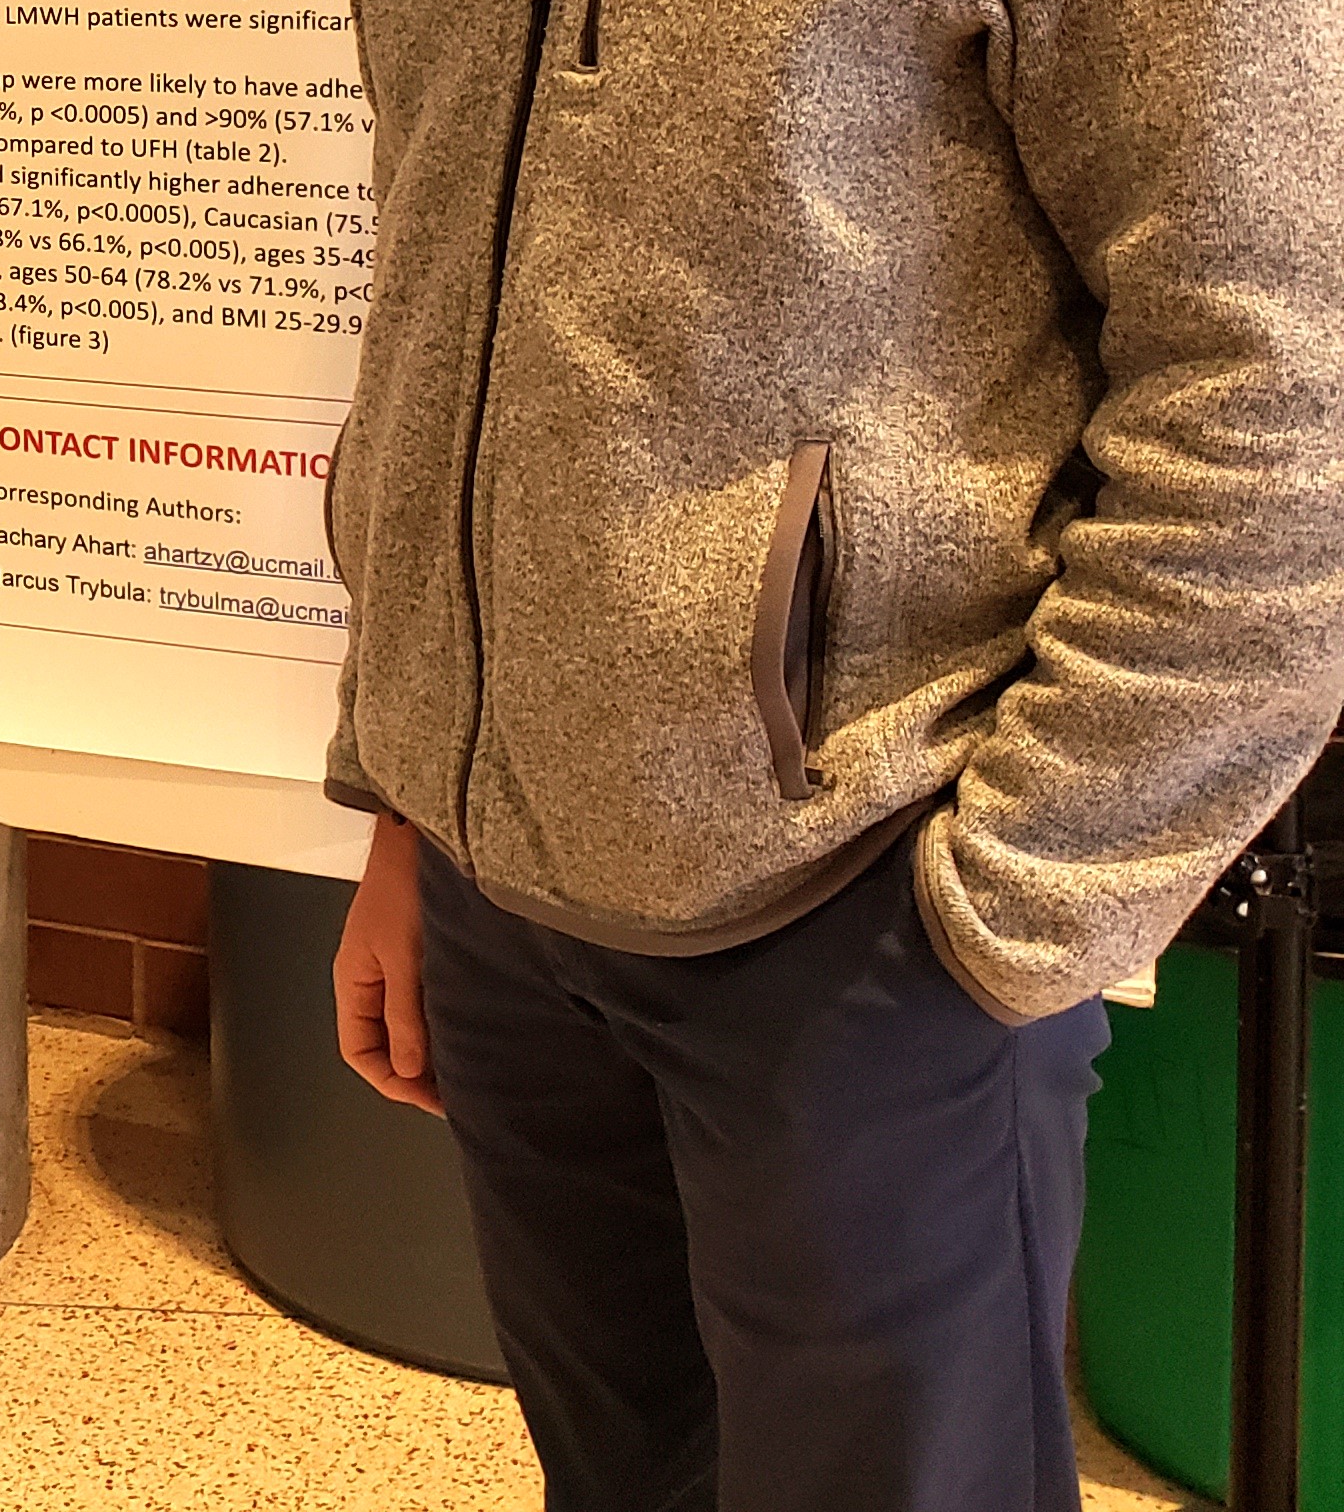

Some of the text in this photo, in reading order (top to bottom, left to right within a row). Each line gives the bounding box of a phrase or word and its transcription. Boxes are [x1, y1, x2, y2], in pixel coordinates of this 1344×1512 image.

[129, 438, 335, 481] INFORMATIO
[146, 497, 241, 524] Authors:
[72, 534, 137, 559] Ahart:
[143, 541, 340, 584] ahartzy@ucmail.
[65, 573, 152, 604] Trybula:
[159, 586, 350, 629] trybulma@ucmai
